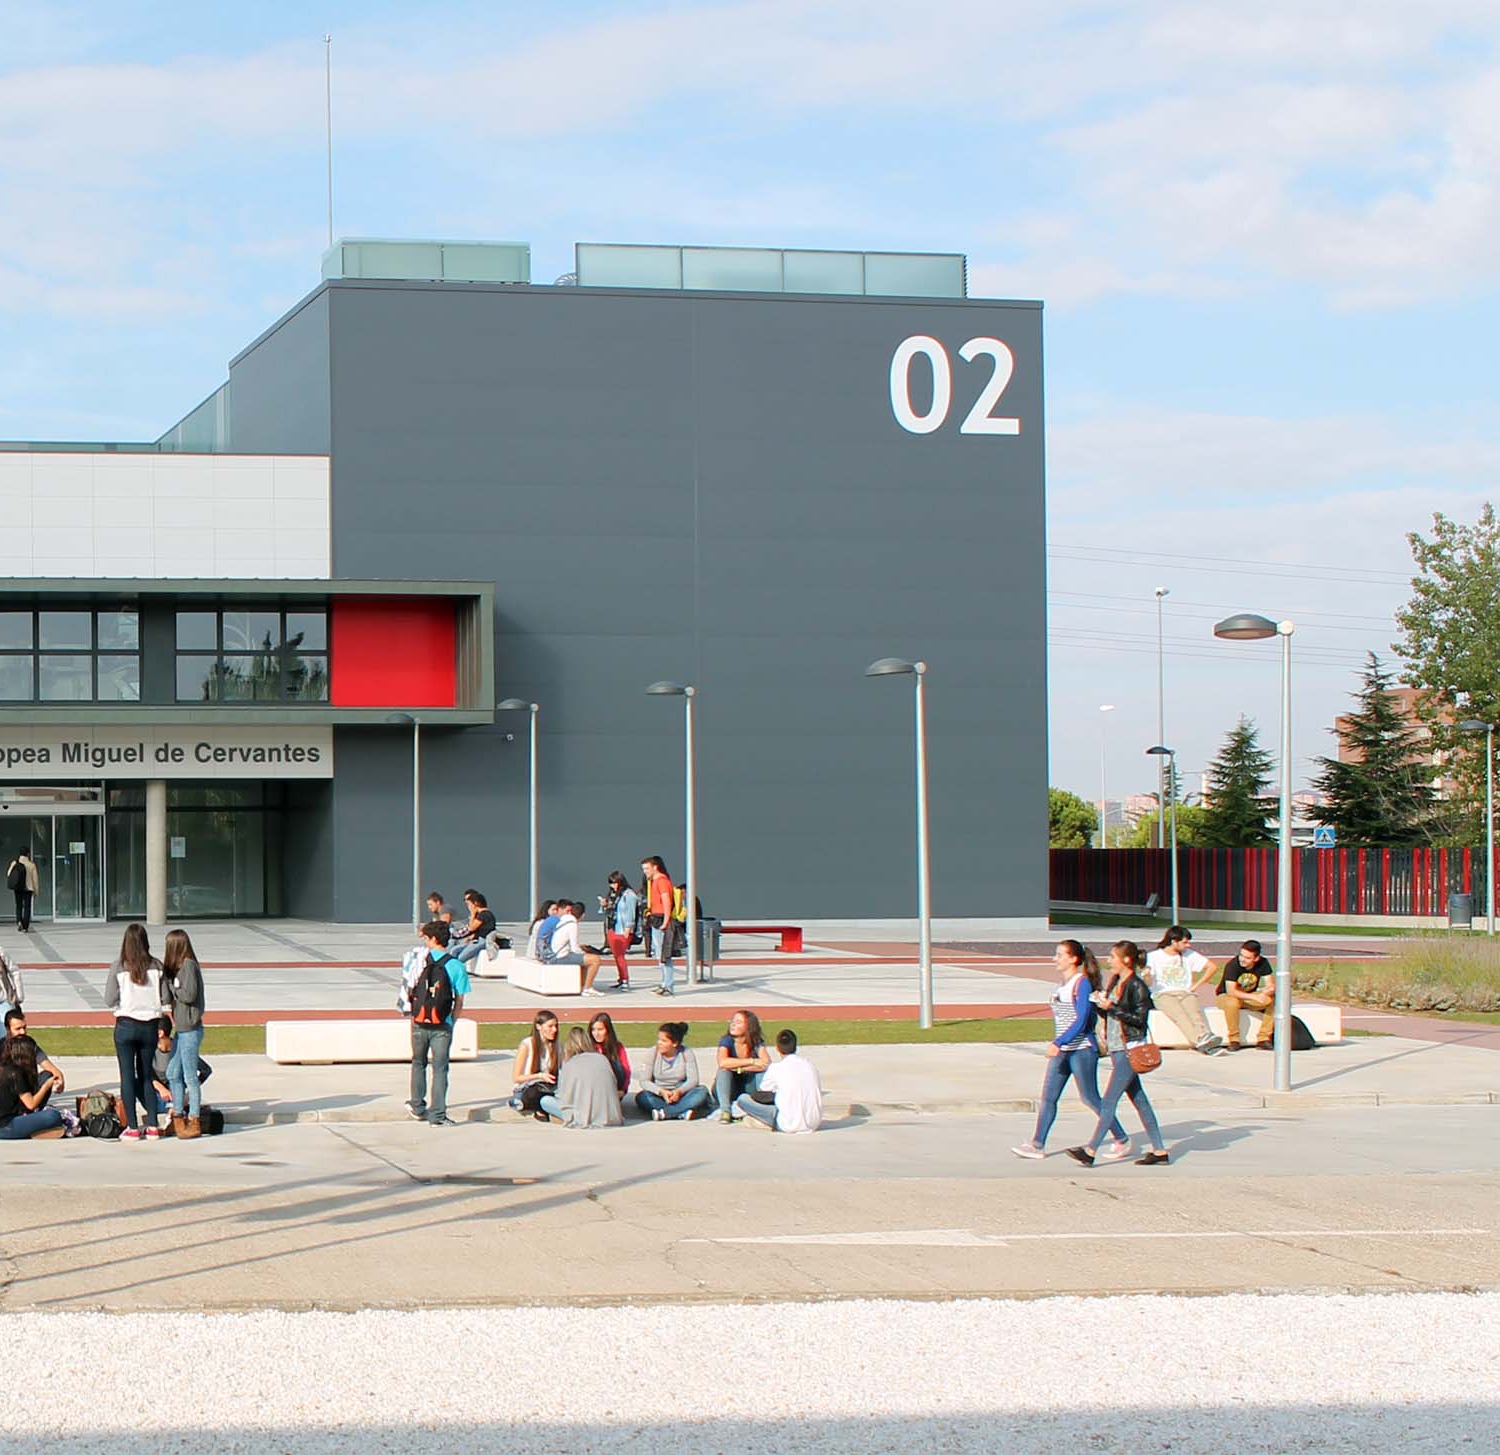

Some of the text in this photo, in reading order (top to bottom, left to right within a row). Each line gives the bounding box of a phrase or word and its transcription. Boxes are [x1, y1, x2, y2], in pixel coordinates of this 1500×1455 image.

[890, 335, 1020, 435] 02
[61, 742, 145, 768] Miguel
[154, 742, 185, 763] de
[194, 742, 321, 763] Cervantes
